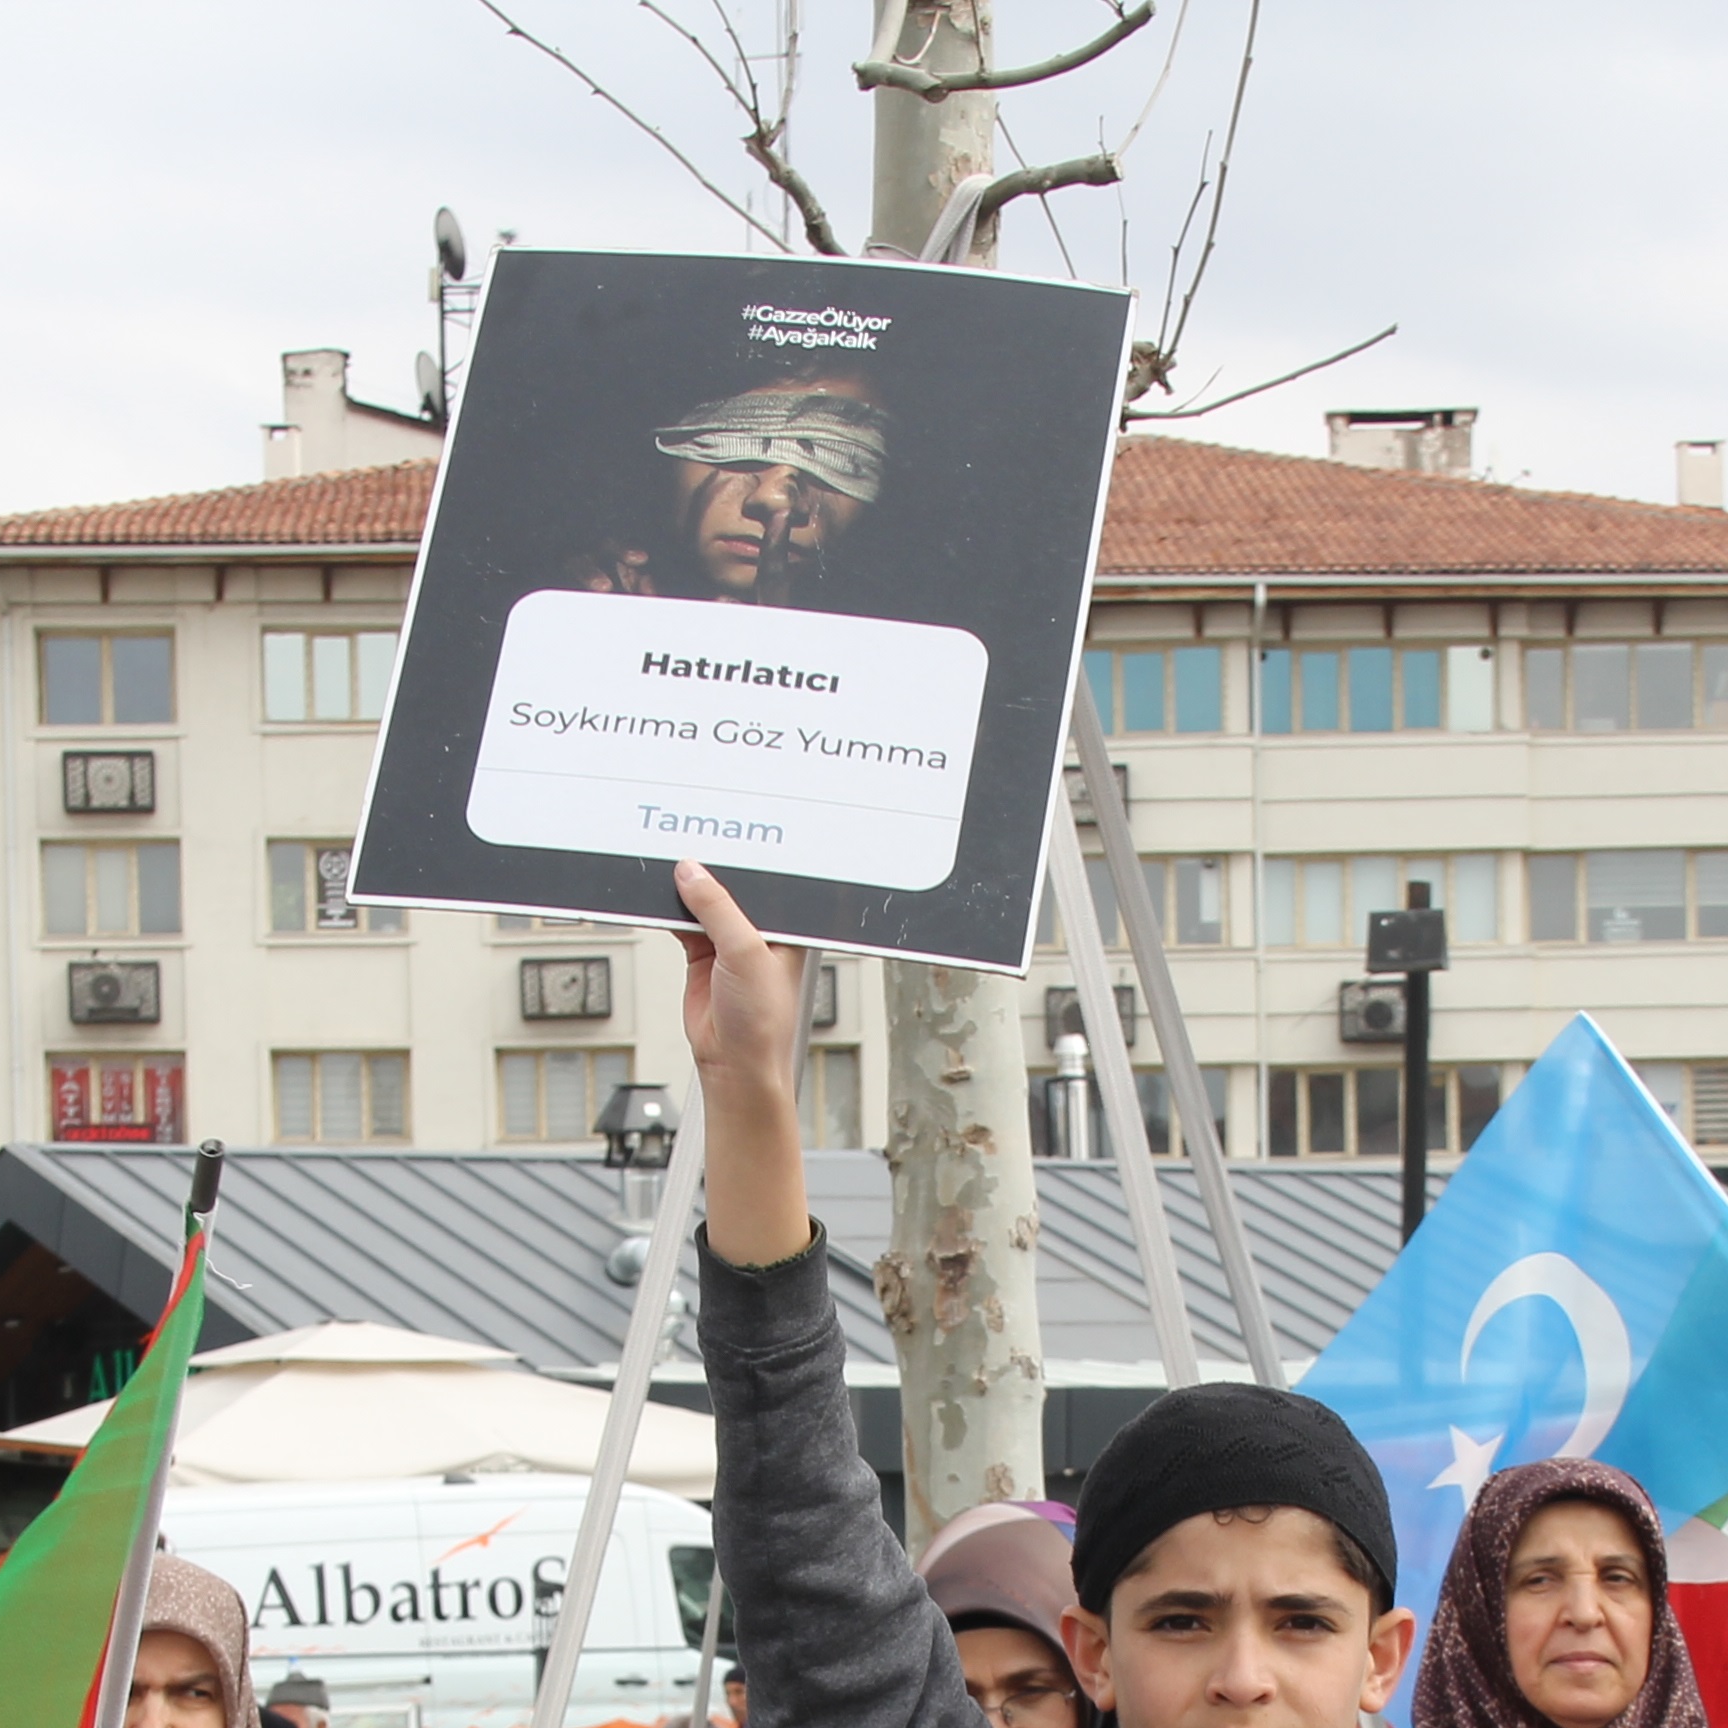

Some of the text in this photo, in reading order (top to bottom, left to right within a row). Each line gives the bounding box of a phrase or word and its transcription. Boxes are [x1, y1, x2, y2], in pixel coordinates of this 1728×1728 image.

[741, 304, 892, 332] #GazzeÖlüyor
[747, 324, 878, 350] #AyağaKalk
[641, 651, 841, 694] Hatırlatıcı
[509, 702, 948, 769] Soykırıma Göz Yumma
[637, 804, 785, 844] Tamam
